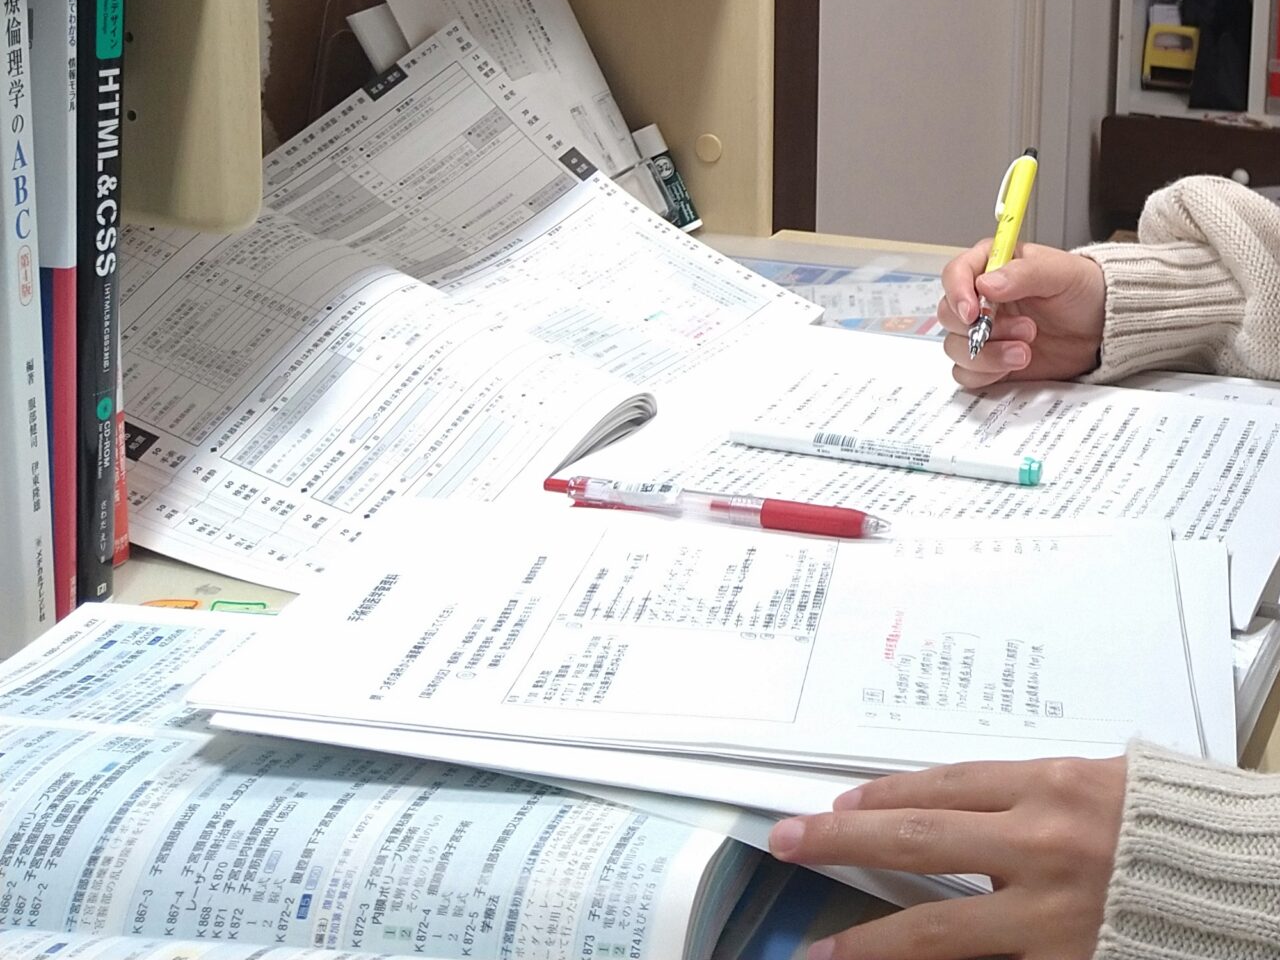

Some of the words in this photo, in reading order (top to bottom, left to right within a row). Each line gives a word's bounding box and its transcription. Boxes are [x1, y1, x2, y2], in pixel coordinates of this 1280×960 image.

[282, 297, 365, 379] の項目は外来診療料に含まれる
[102, 420, 111, 468] CD-ROM
[371, 824, 420, 924] 内膜ポリープ切除術
[26, 882, 48, 926] K867-2
[132, 887, 154, 933] K867-3
[163, 889, 184, 935] K867-4
[212, 907, 227, 938] K871
[227, 907, 244, 940] K872
[274, 896, 295, 942] K872-2
[351, 902, 369, 947] K872-3
[479, 894, 499, 933] 学療法
[414, 907, 431, 952] K872-4
[461, 910, 479, 955] K872-5
